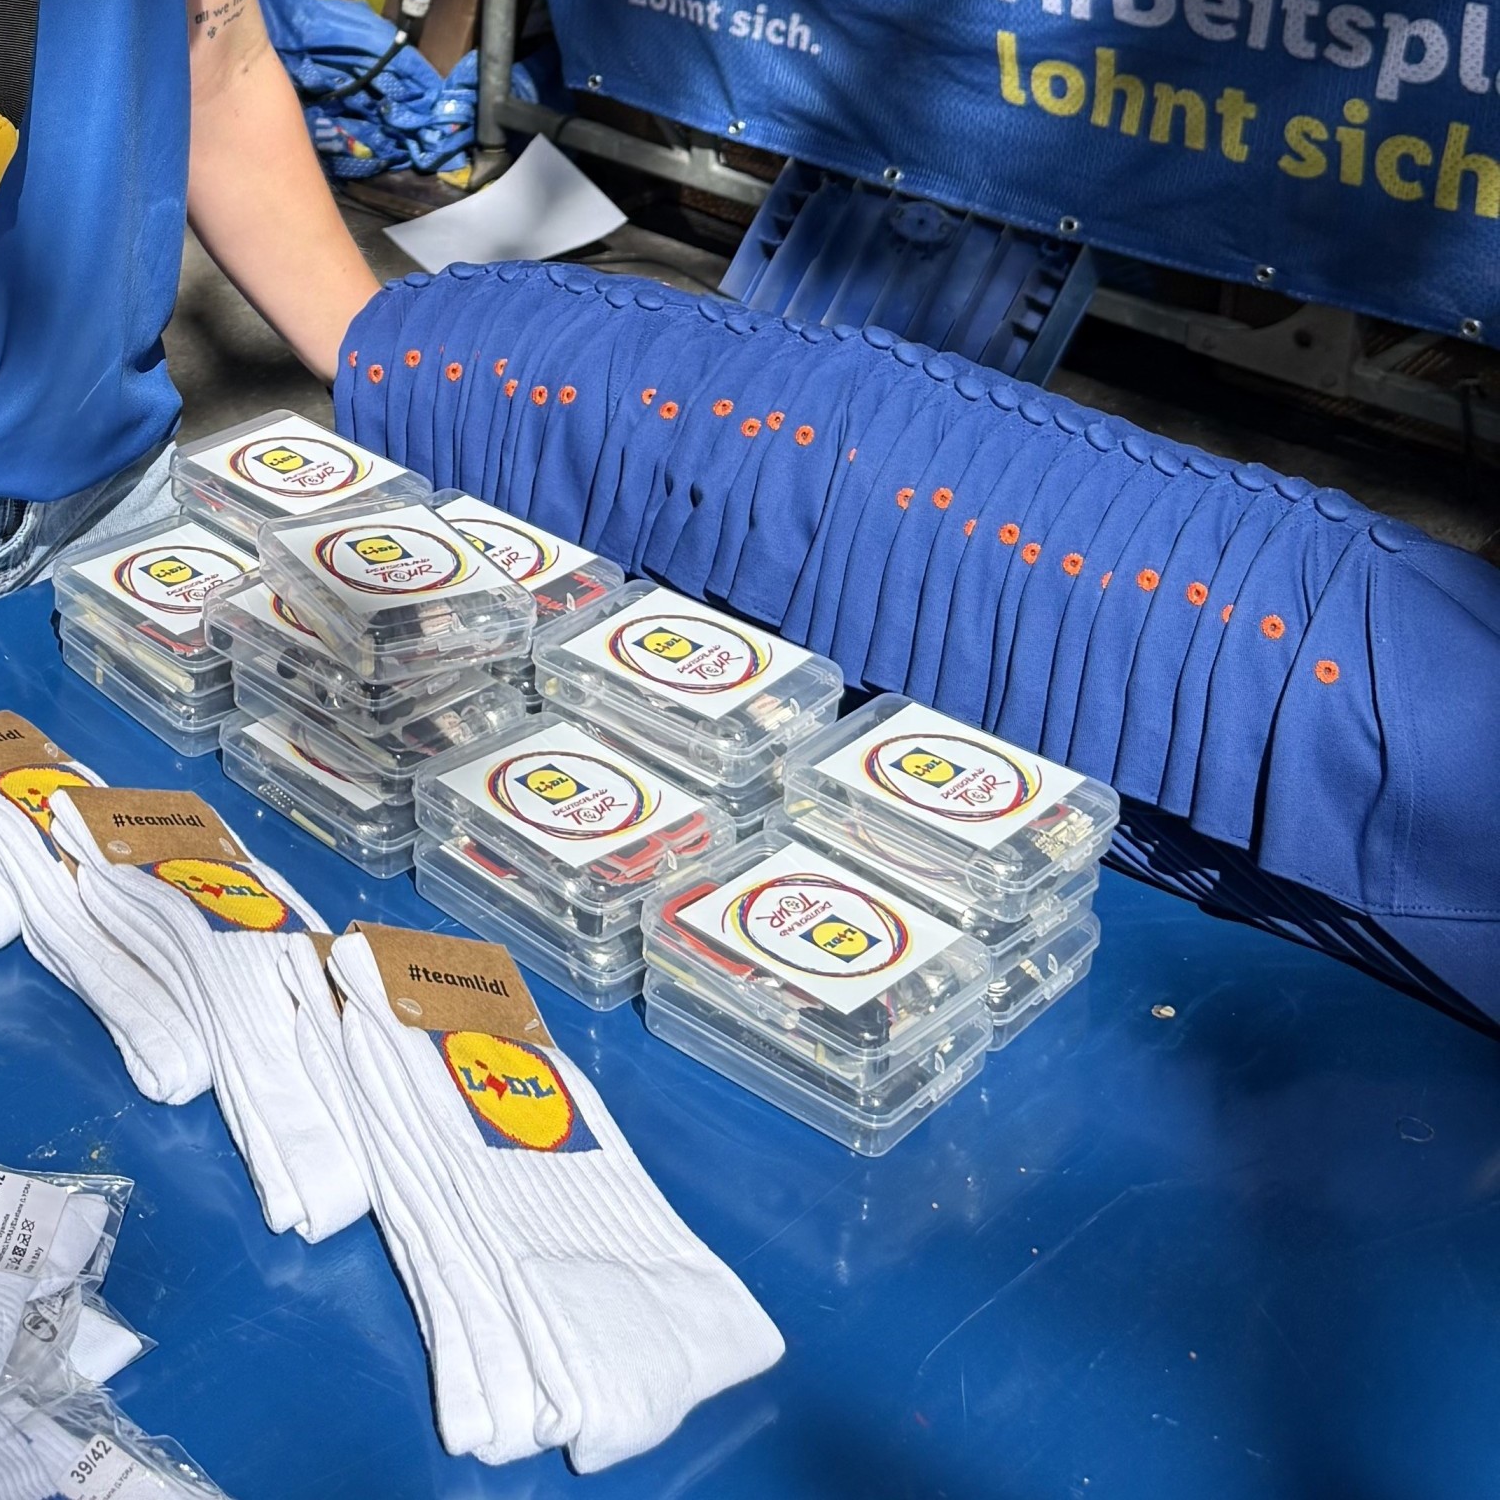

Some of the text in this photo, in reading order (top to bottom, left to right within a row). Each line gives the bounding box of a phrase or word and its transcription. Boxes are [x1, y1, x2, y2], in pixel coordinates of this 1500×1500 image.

[728, 3, 823, 56] sich.
[997, 31, 1257, 163] lohnt
[373, 564, 442, 583] TOUR
[688, 650, 744, 680] TOUR
[952, 774, 1011, 807] TOUR
[112, 811, 206, 829] #teamlidl
[562, 796, 628, 826] TOUR
[408, 963, 510, 998] #teamlidl
[70, 1440, 113, 1485] 39/42
